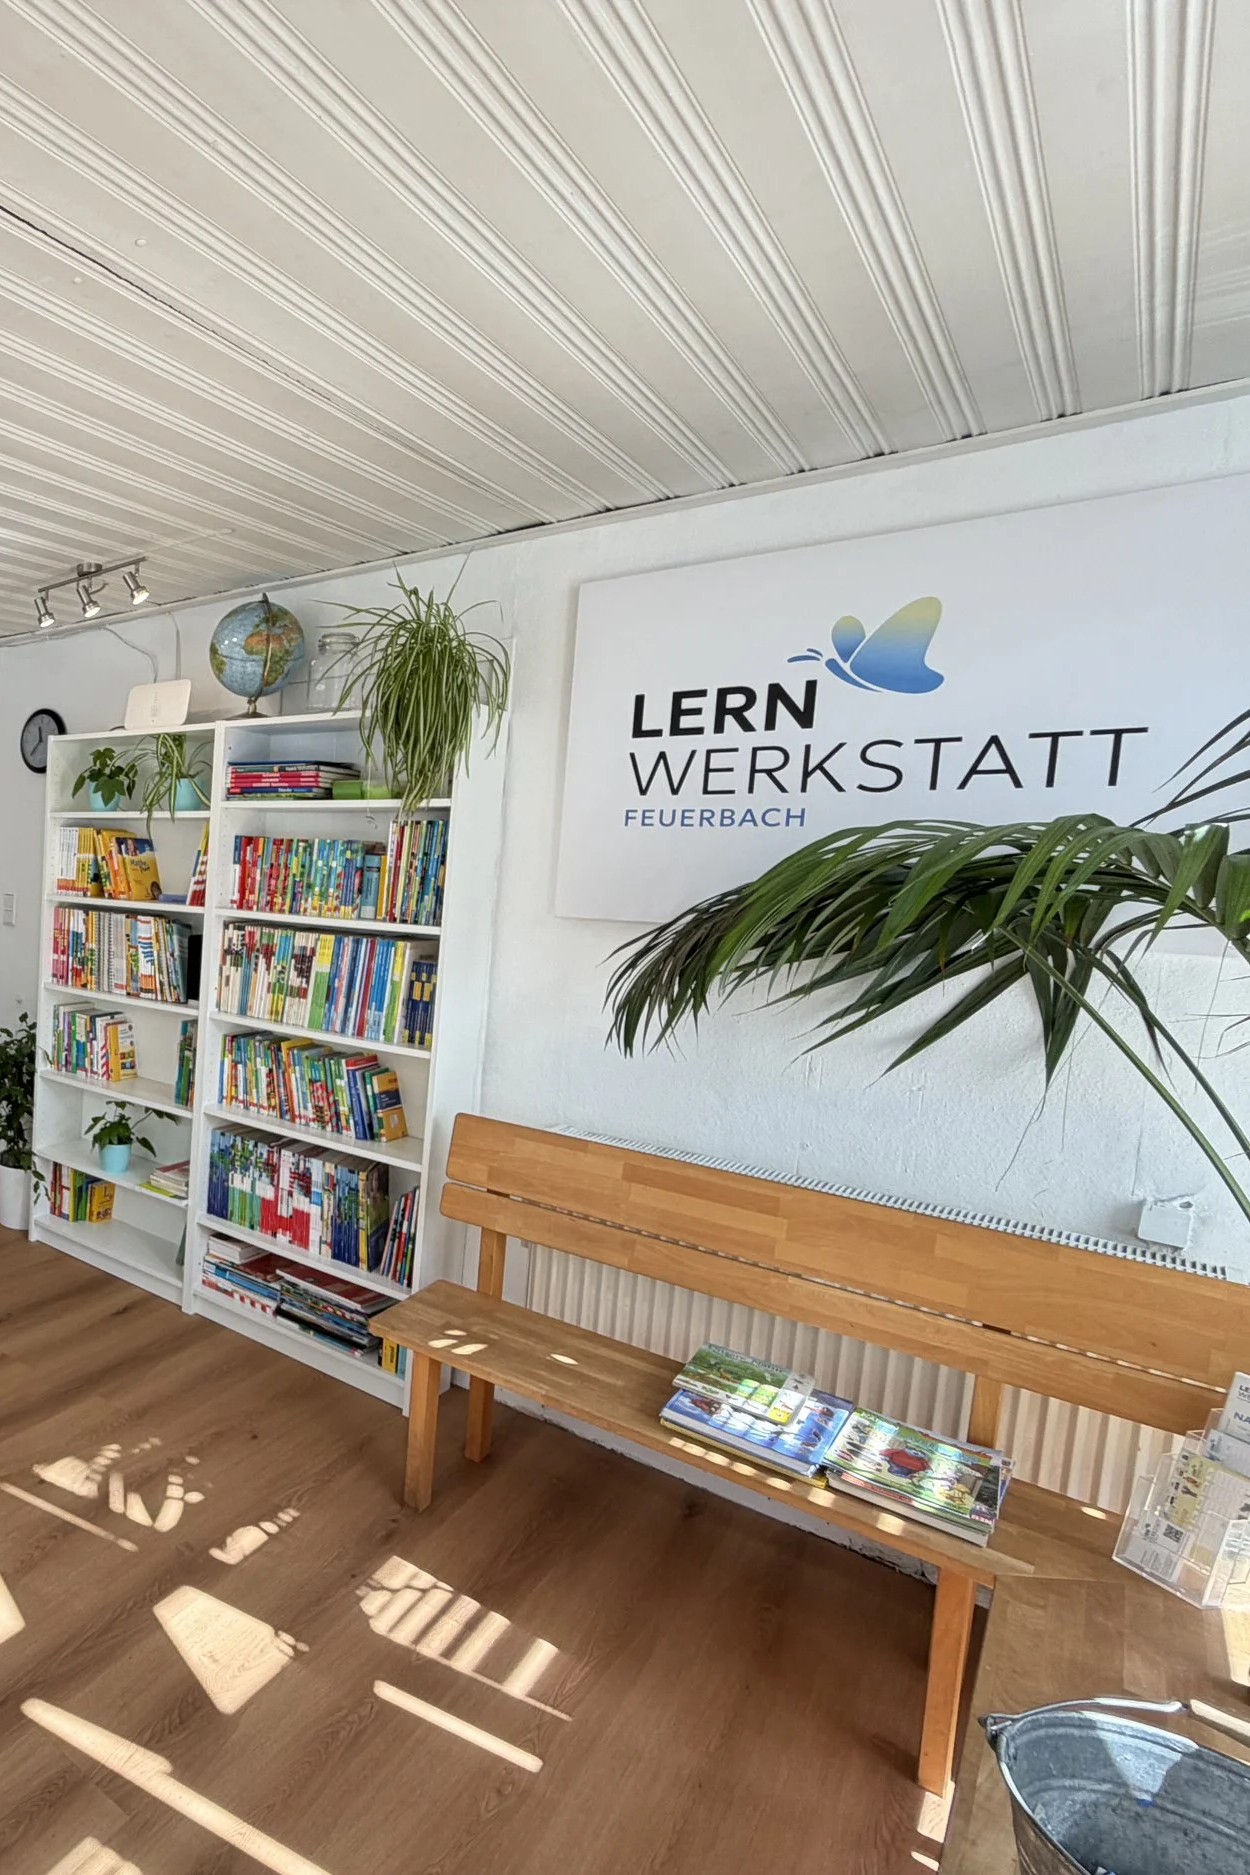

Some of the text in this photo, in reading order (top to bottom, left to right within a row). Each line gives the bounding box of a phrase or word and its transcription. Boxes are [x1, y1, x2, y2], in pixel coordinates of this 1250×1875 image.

[631, 679, 818, 739] LERN
[629, 726, 1150, 796] WERKSTATT
[624, 807, 807, 828] FEUERBACH
